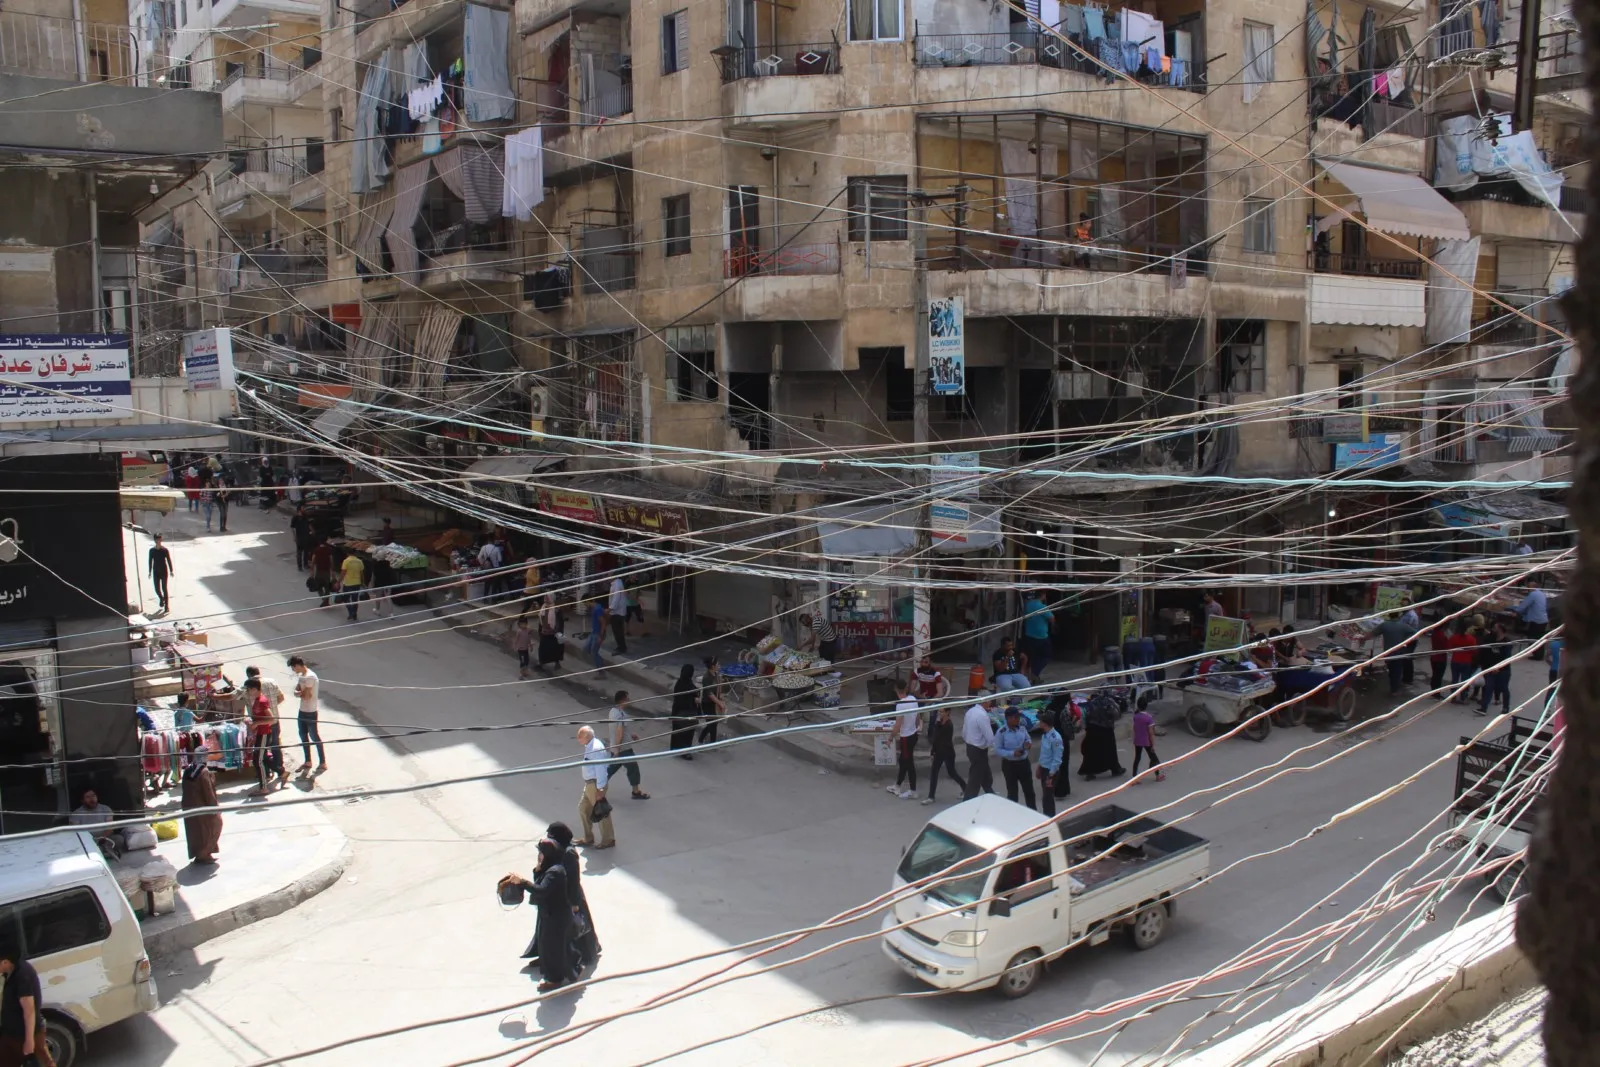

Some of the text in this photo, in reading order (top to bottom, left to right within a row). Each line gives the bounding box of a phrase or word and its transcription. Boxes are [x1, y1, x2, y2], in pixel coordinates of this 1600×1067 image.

[25, 337, 69, 349] السنية
[71, 337, 111, 349] العيادة
[38, 353, 92, 377] شرفان
[94, 360, 127, 371] الدكتور
[608, 508, 626, 523] EYE
